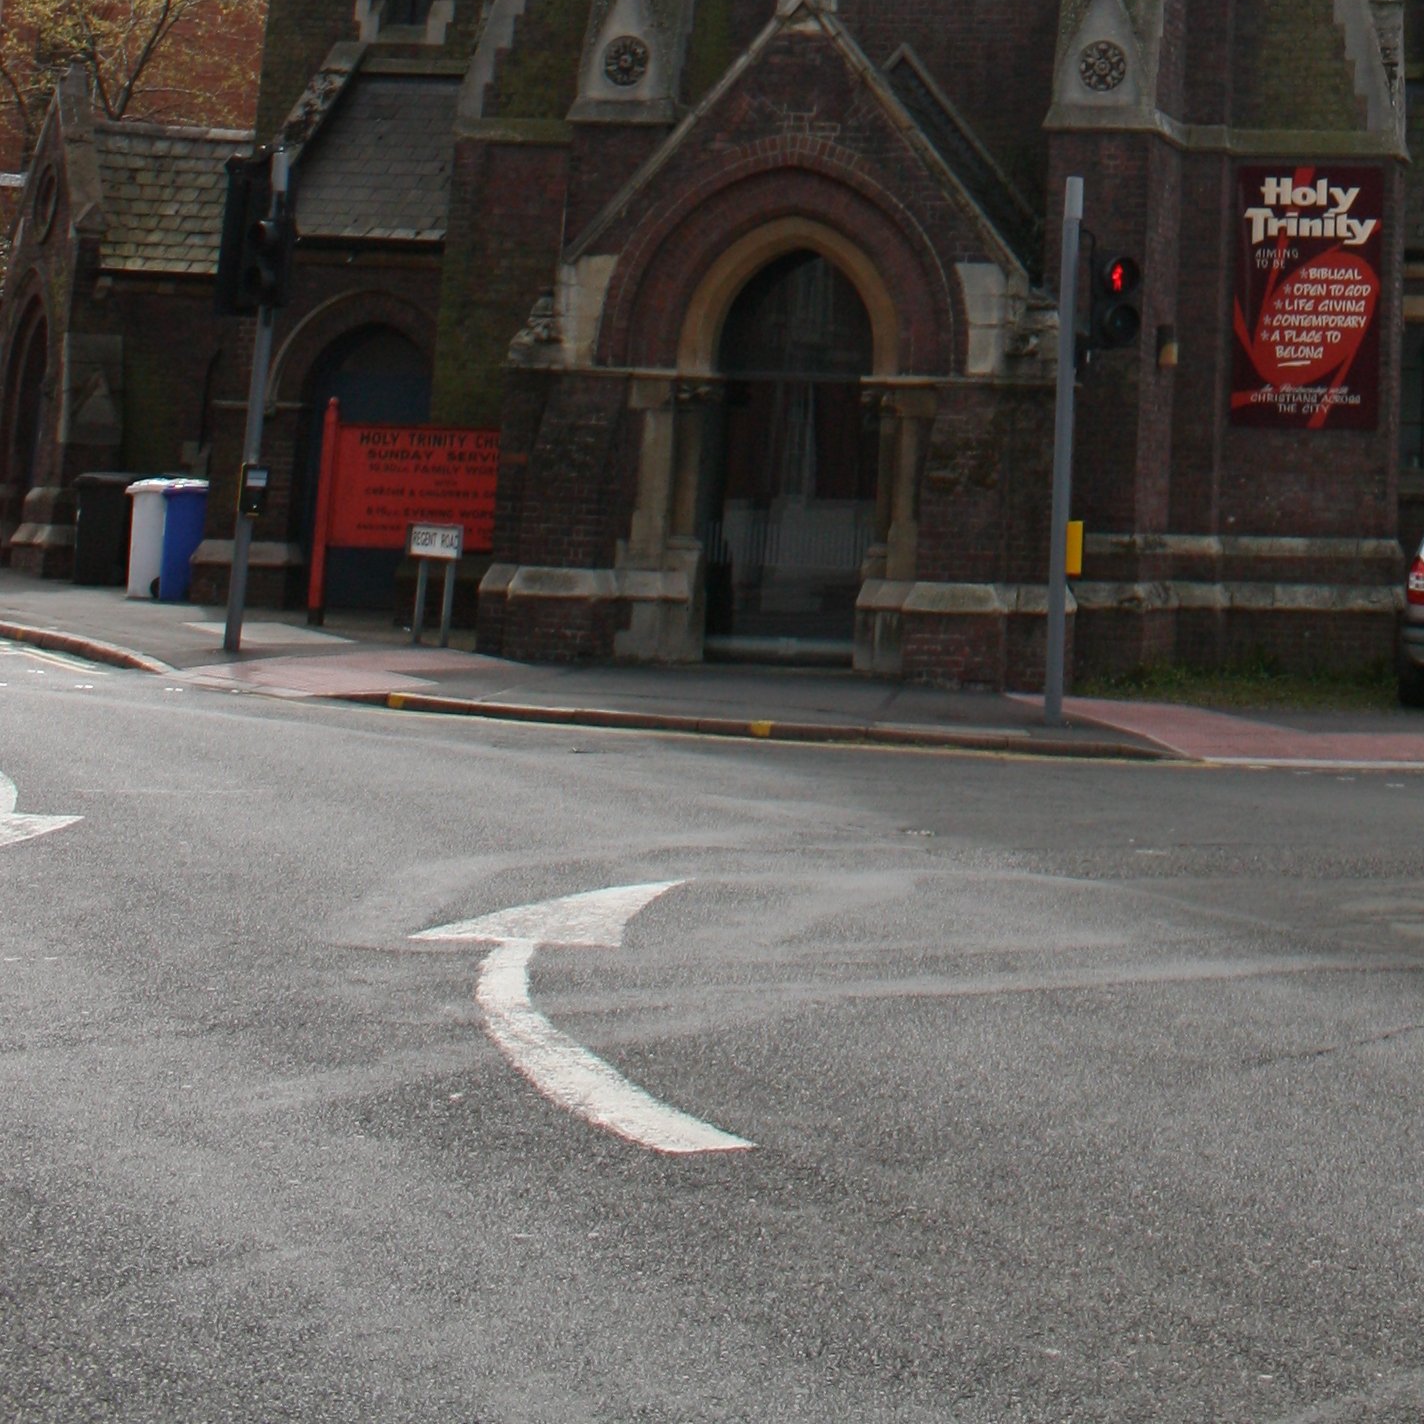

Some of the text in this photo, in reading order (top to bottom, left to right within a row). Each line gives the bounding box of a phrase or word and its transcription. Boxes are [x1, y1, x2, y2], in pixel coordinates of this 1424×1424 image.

[1260, 177, 1360, 213] Holy
[1244, 208, 1377, 245] Trinity
[1255, 248, 1299, 259] AIMING
[1256, 258, 1286, 269] TO BE
[1308, 267, 1362, 280] BIBLICAL
[1293, 283, 1371, 297] OPEN TO GOD
[1285, 298, 1365, 312] LIFE GIVING
[1272, 315, 1366, 328] CONTEMPORARY
[1270, 330, 1341, 342] A PLACE TO
[1275, 345, 1323, 359] BELONG
[1250, 391, 1318, 404] CHRISTIANS
[1279, 403, 1330, 414] THE CITY
[359, 432, 400, 448] HOLY
[408, 433, 467, 448] TRINITY
[367, 449, 433, 461] SUNDAY
[413, 530, 438, 547] REGENT
[440, 531, 459, 548] ROAD
